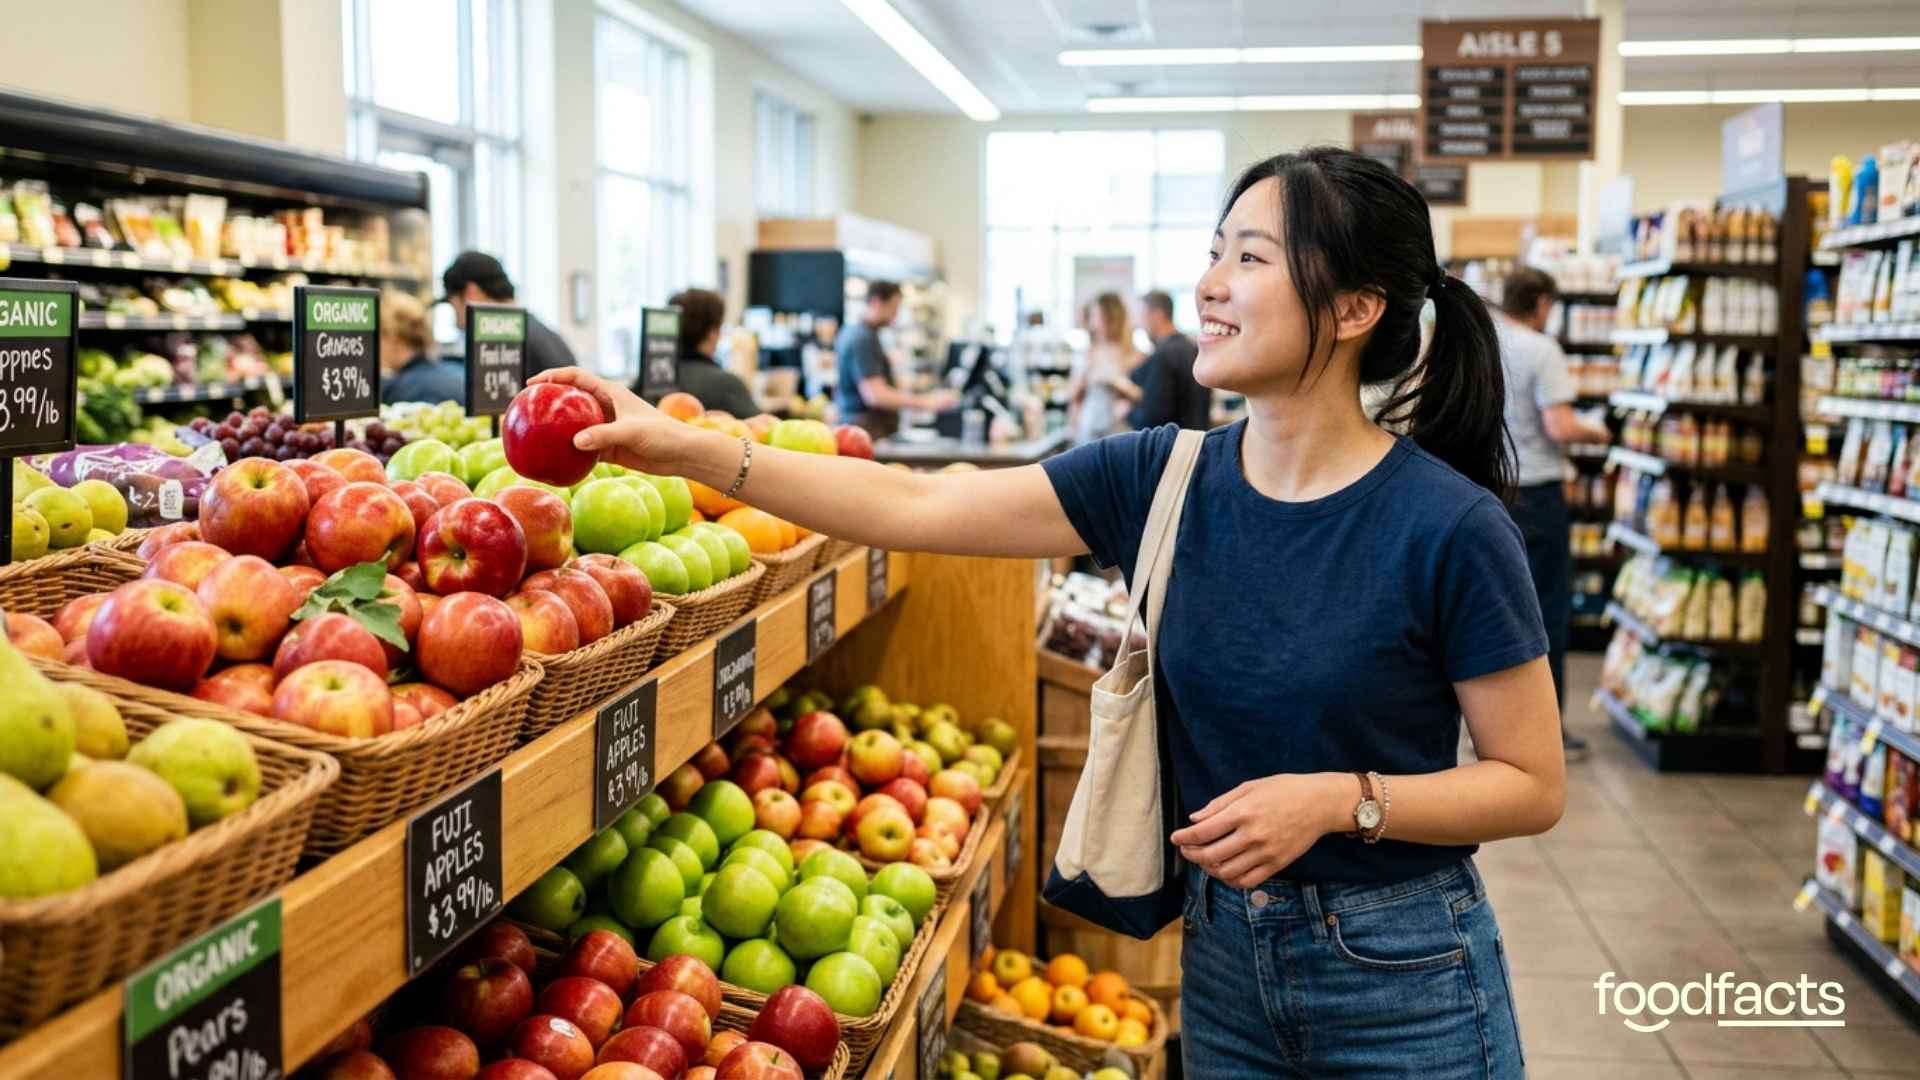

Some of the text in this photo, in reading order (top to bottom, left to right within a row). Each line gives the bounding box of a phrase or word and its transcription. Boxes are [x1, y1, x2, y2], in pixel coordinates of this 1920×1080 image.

[1457, 30, 1538, 58] AISLE
[313, 301, 369, 323] ORGANIC
[322, 366, 370, 400] $3.99/lb
[606, 724, 646, 771] APPLES
[432, 799, 473, 852] FUJI
[424, 830, 484, 898] APPLES
[428, 875, 494, 939] $3.99/lb
[154, 920, 260, 1011] ORGANIC
[167, 998, 248, 1079] Pears
